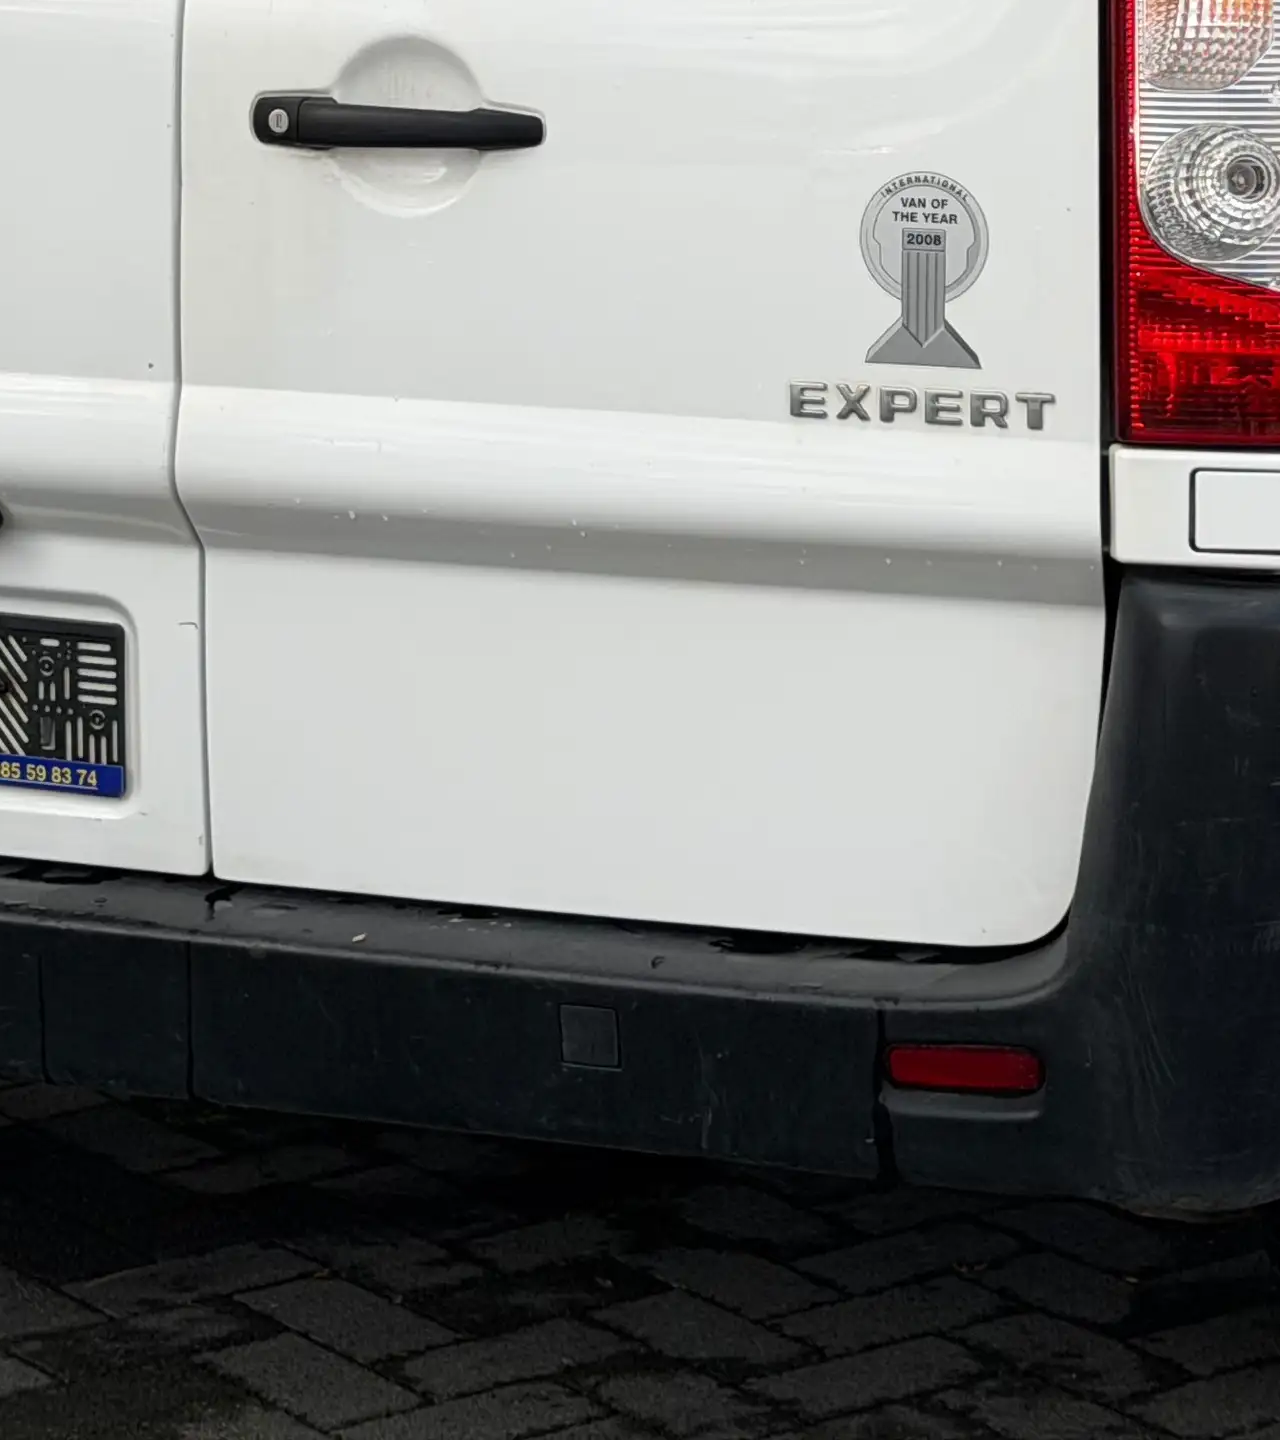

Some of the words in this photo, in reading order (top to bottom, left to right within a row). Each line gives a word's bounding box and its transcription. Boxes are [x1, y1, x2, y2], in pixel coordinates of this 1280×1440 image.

[880, 175, 969, 203] INTERNATIONAL
[900, 197, 926, 209] VAN
[930, 199, 949, 210] OF
[892, 211, 918, 223] THE
[922, 212, 958, 224] YEAR
[906, 233, 942, 246] 2008
[789, 380, 1056, 430] EXPERT
[26, 764, 47, 782] 59
[51, 767, 72, 784] 83
[76, 769, 97, 786] 74
